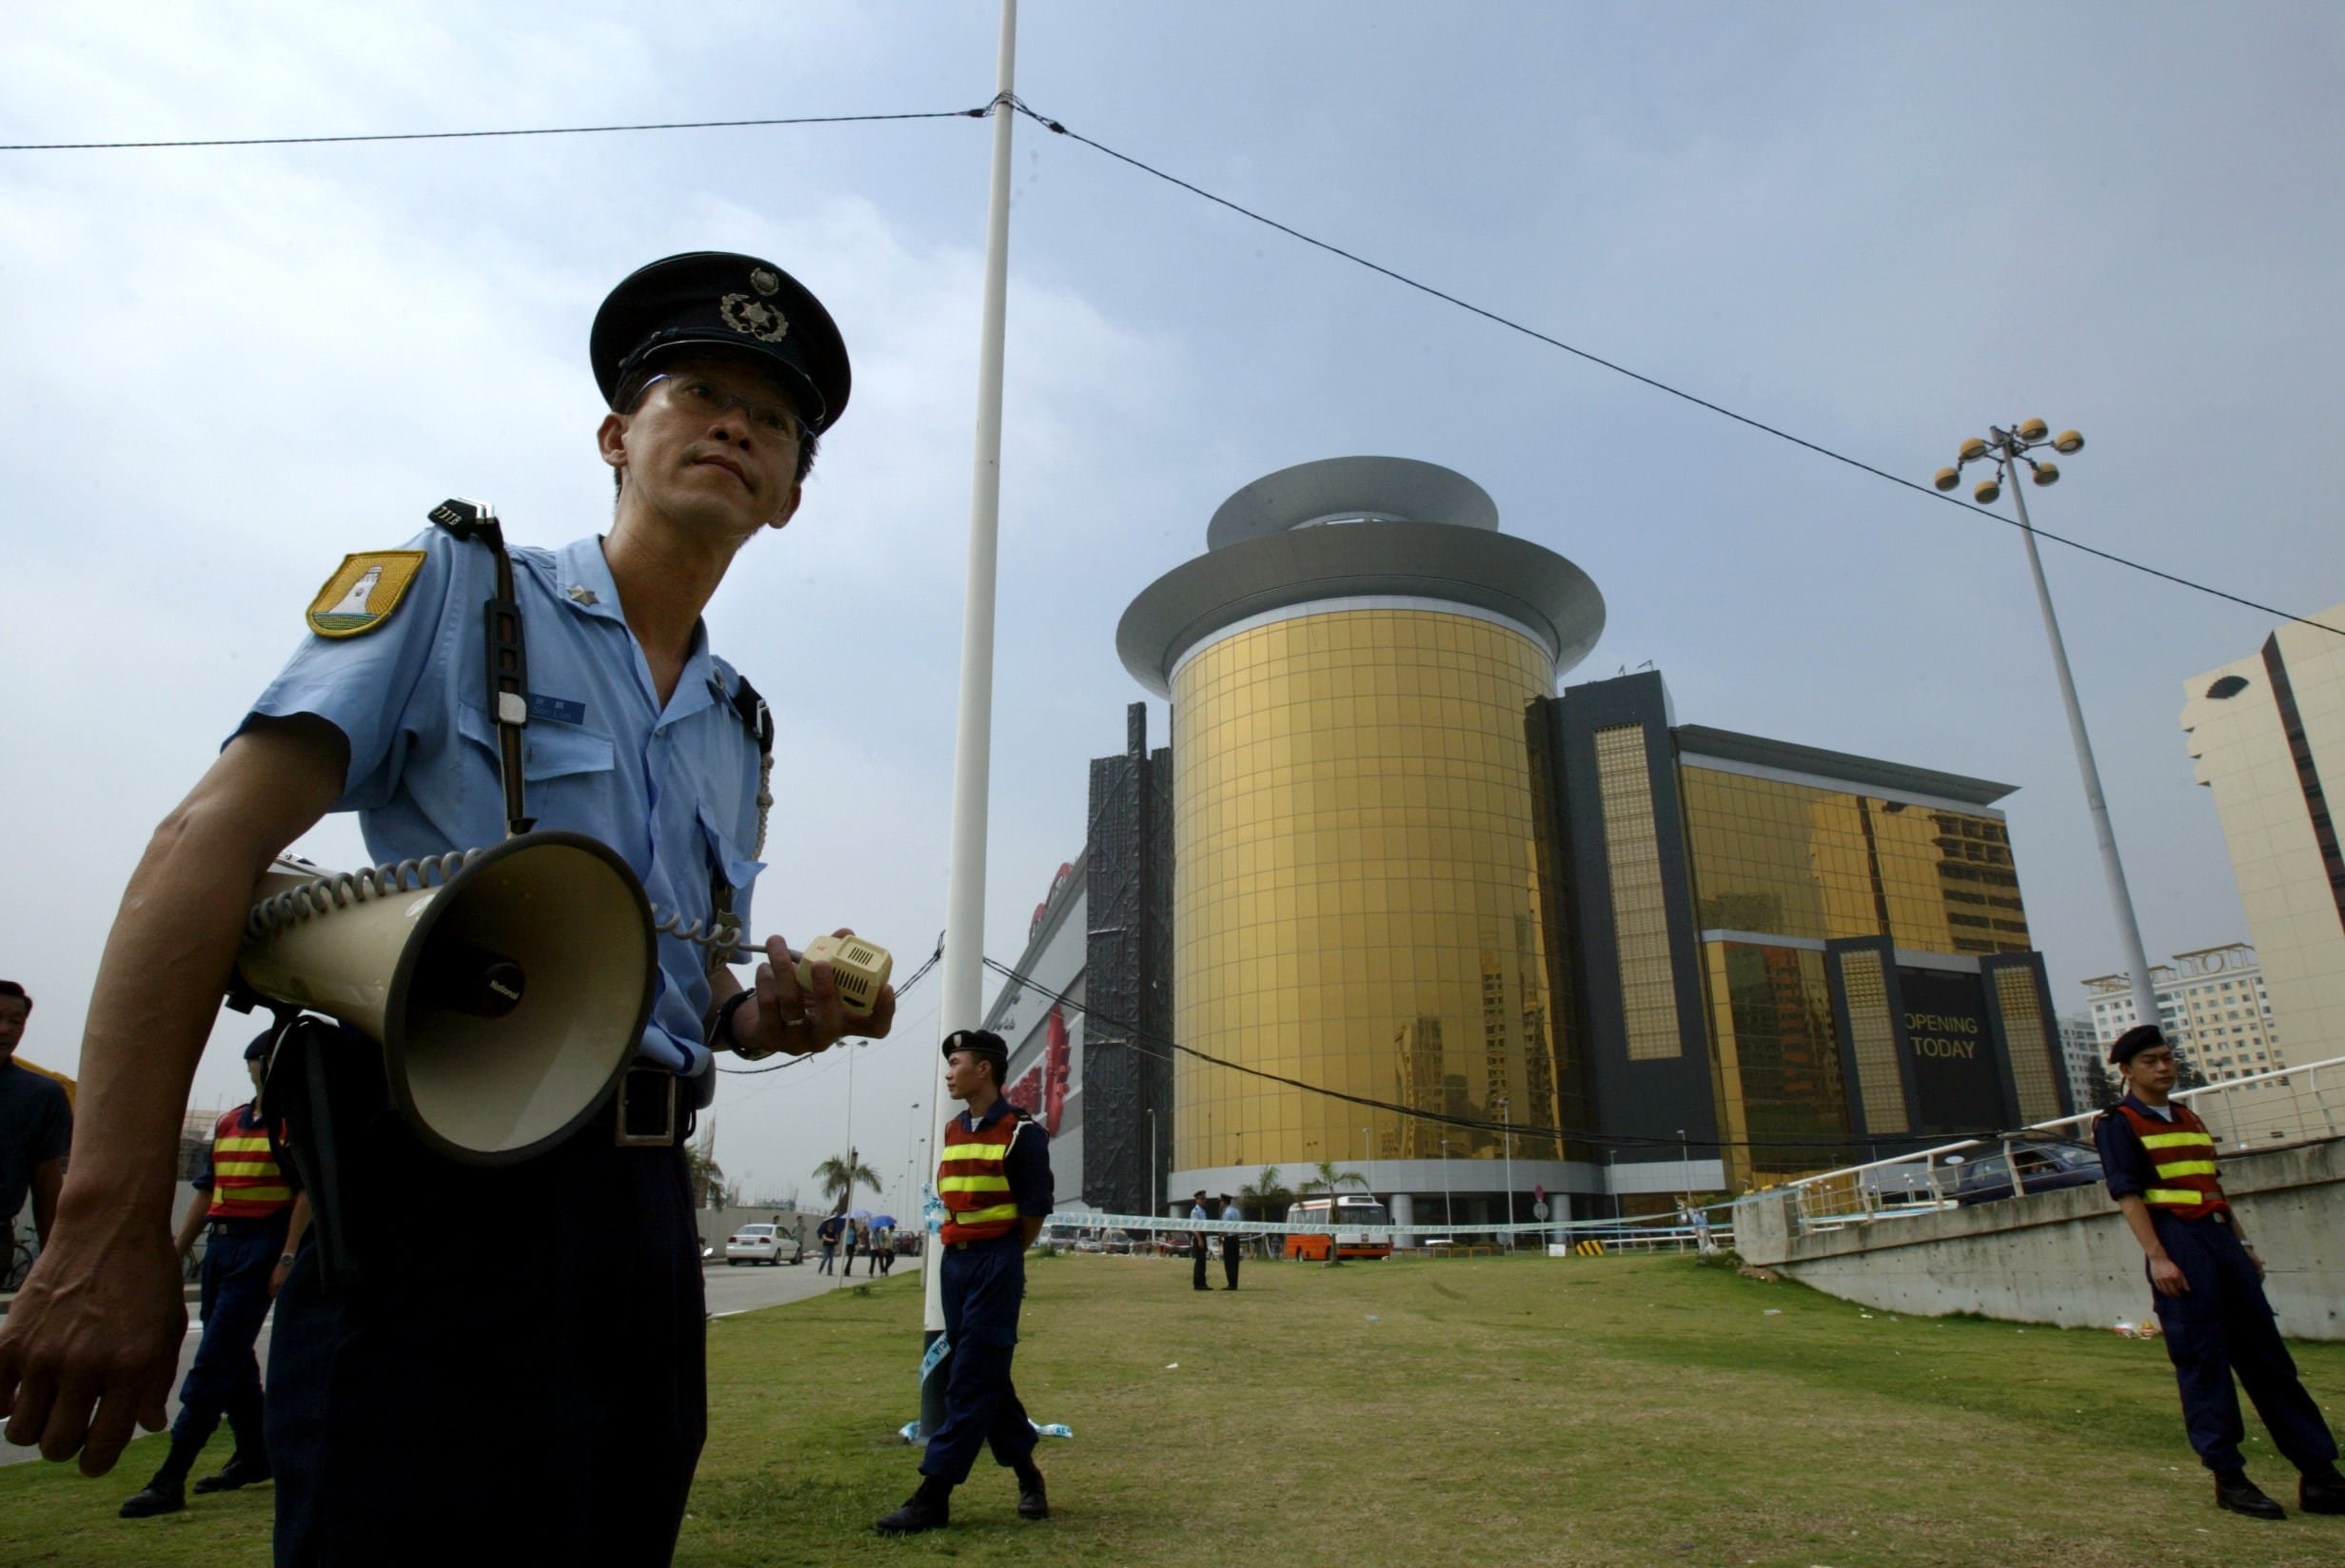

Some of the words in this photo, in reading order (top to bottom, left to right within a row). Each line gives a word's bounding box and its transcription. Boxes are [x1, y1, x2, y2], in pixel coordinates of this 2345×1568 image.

[489, 979, 521, 1001] National
[1903, 1012, 1979, 1034] OPENING
[1910, 1036, 1977, 1059] TODAY
